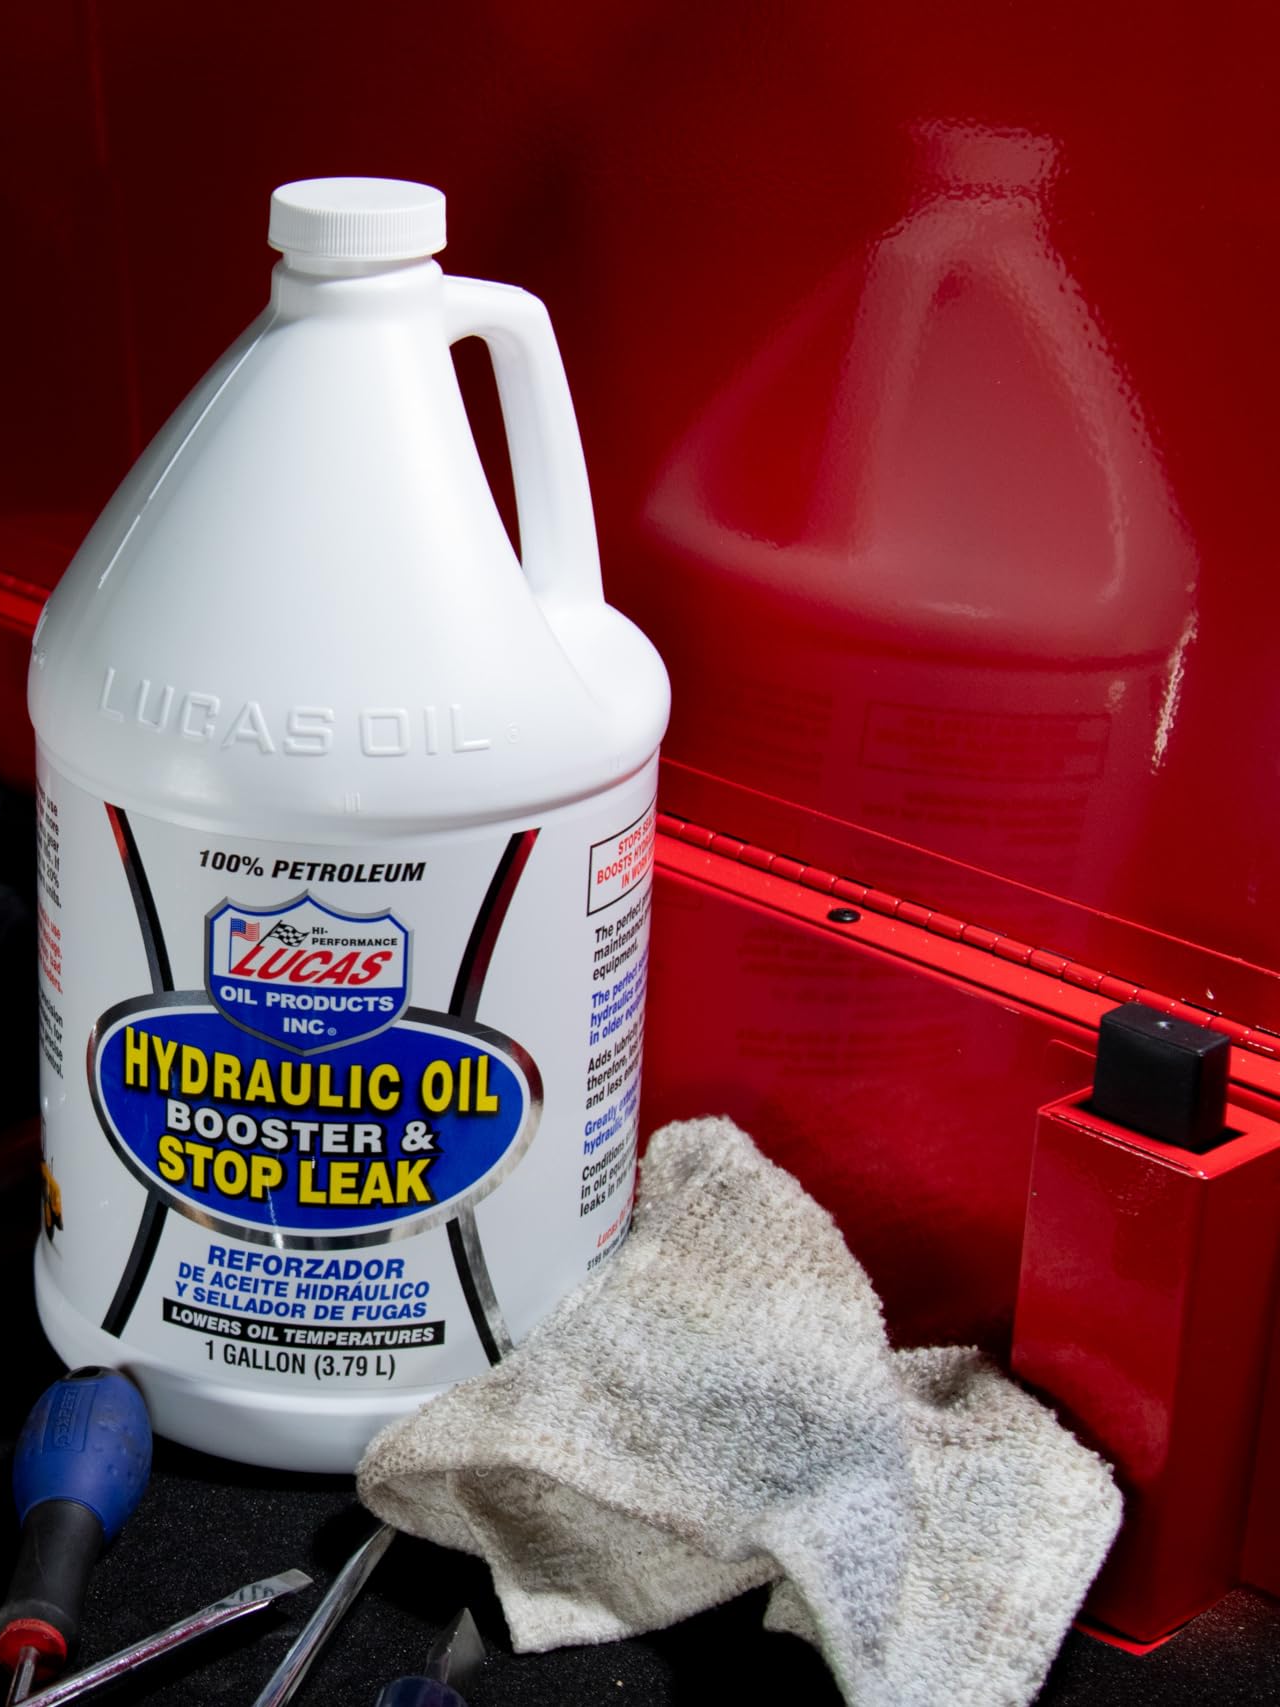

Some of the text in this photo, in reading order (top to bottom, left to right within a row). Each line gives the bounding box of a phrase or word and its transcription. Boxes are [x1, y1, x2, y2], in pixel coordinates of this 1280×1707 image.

[99, 667, 336, 757] LUCAS
[360, 703, 491, 757] OIL
[618, 827, 641, 855] STOPS
[199, 850, 427, 883] 100% PETROLEUM
[596, 852, 632, 885] BOOSTS
[621, 871, 630, 889] IN
[312, 926, 329, 936] HI-
[594, 925, 614, 943] The
[616, 899, 641, 936] perfect
[312, 936, 399, 947] PERFORMANCE
[229, 944, 393, 985] LUCAS
[220, 985, 395, 1012] OIL PRODUCTS
[591, 962, 638, 1008] The perfect
[590, 986, 634, 1028] hydraulics
[589, 1031, 600, 1046] in
[602, 1013, 624, 1039] older
[124, 1025, 500, 1114] HYDRAULIC OIL
[587, 1048, 612, 1074] Adds
[585, 1086, 605, 1110] and
[606, 1074, 623, 1097] less
[166, 1100, 435, 1154] BOOSTER &
[583, 1114, 624, 1156] hydraulic
[584, 1104, 618, 1137] Greatly
[157, 1135, 432, 1207] STOP LEAK
[582, 1139, 625, 1182] Conditions
[579, 1191, 606, 1218] leaks
[607, 1182, 615, 1199] in
[581, 1184, 591, 1201] in
[593, 1169, 607, 1190] old
[178, 1262, 430, 1301] DE ACEITE HIDRÁULICO
[207, 1245, 405, 1281] REFORZADOR
[175, 1281, 428, 1321] Y SELLADOR DE FUGAS
[171, 1305, 435, 1347] LOWERS OIL TEMPERATURES
[205, 1340, 396, 1380] 1 GALLON (3.79 L)
